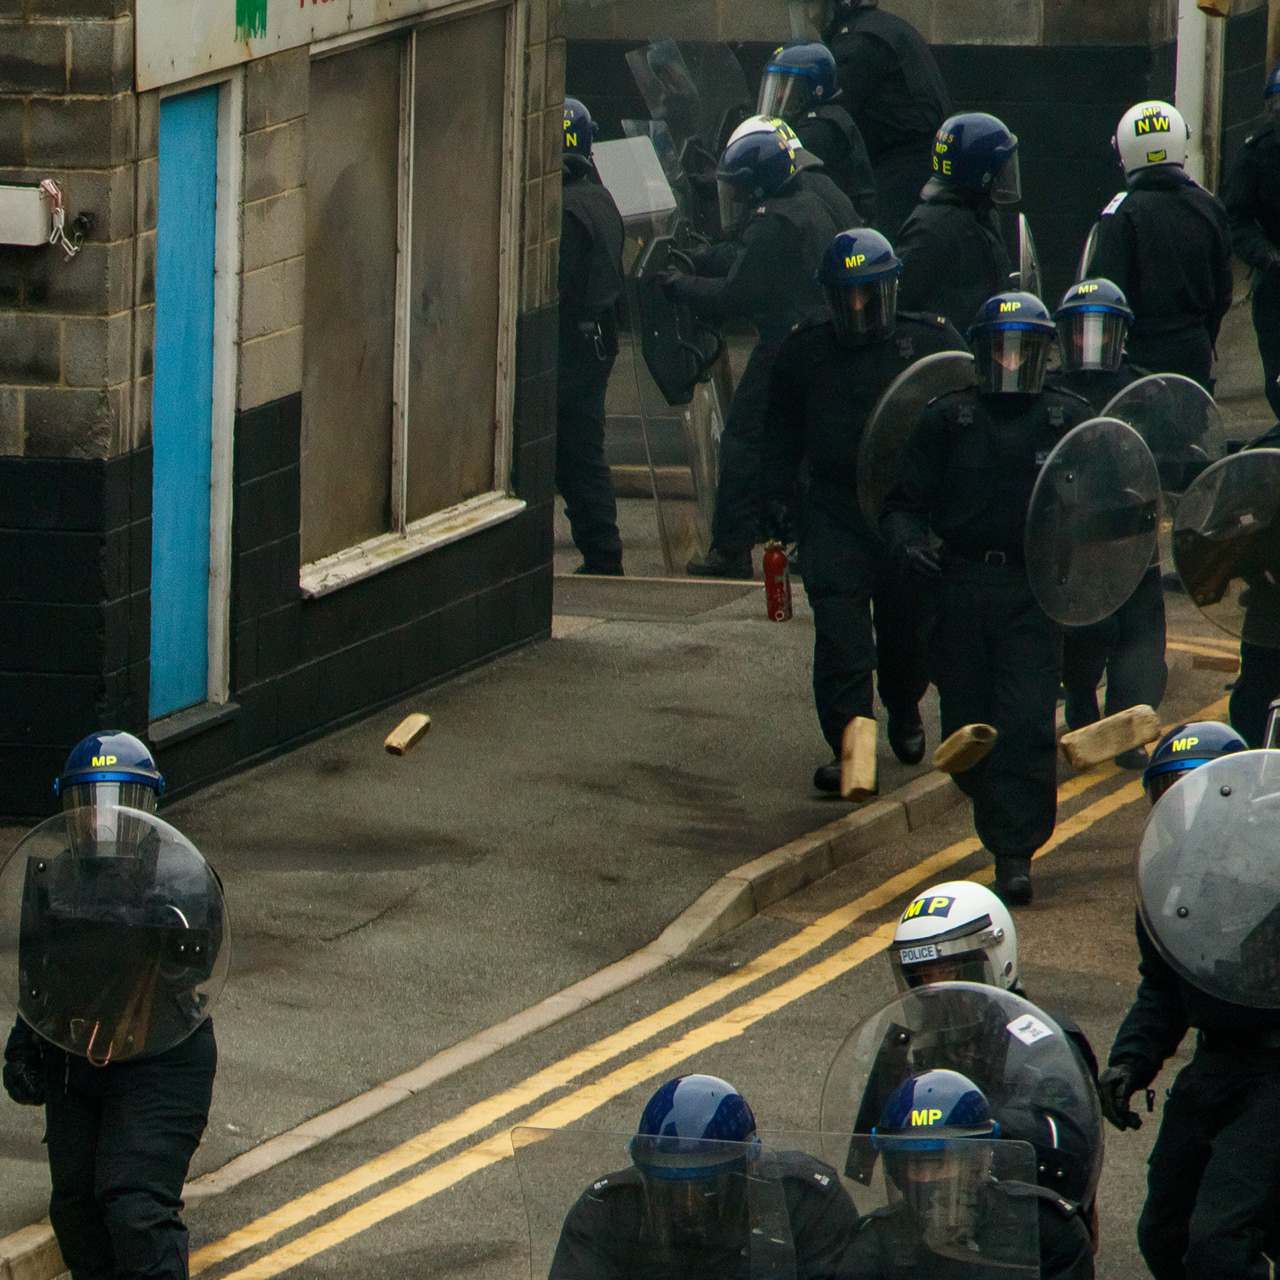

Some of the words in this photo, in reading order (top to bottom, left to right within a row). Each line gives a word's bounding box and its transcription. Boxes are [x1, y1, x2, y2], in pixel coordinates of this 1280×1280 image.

[1142, 107, 1161, 117] MP
[935, 141, 948, 154] MP
[844, 254, 866, 269] MP
[1077, 284, 1099, 295] MP
[999, 301, 1022, 313] MP
[1172, 737, 1199, 752] MP
[91, 755, 118, 767] MP
[904, 897, 949, 919] MP
[902, 946, 935, 962] POLICE
[911, 1109, 943, 1127] MP
